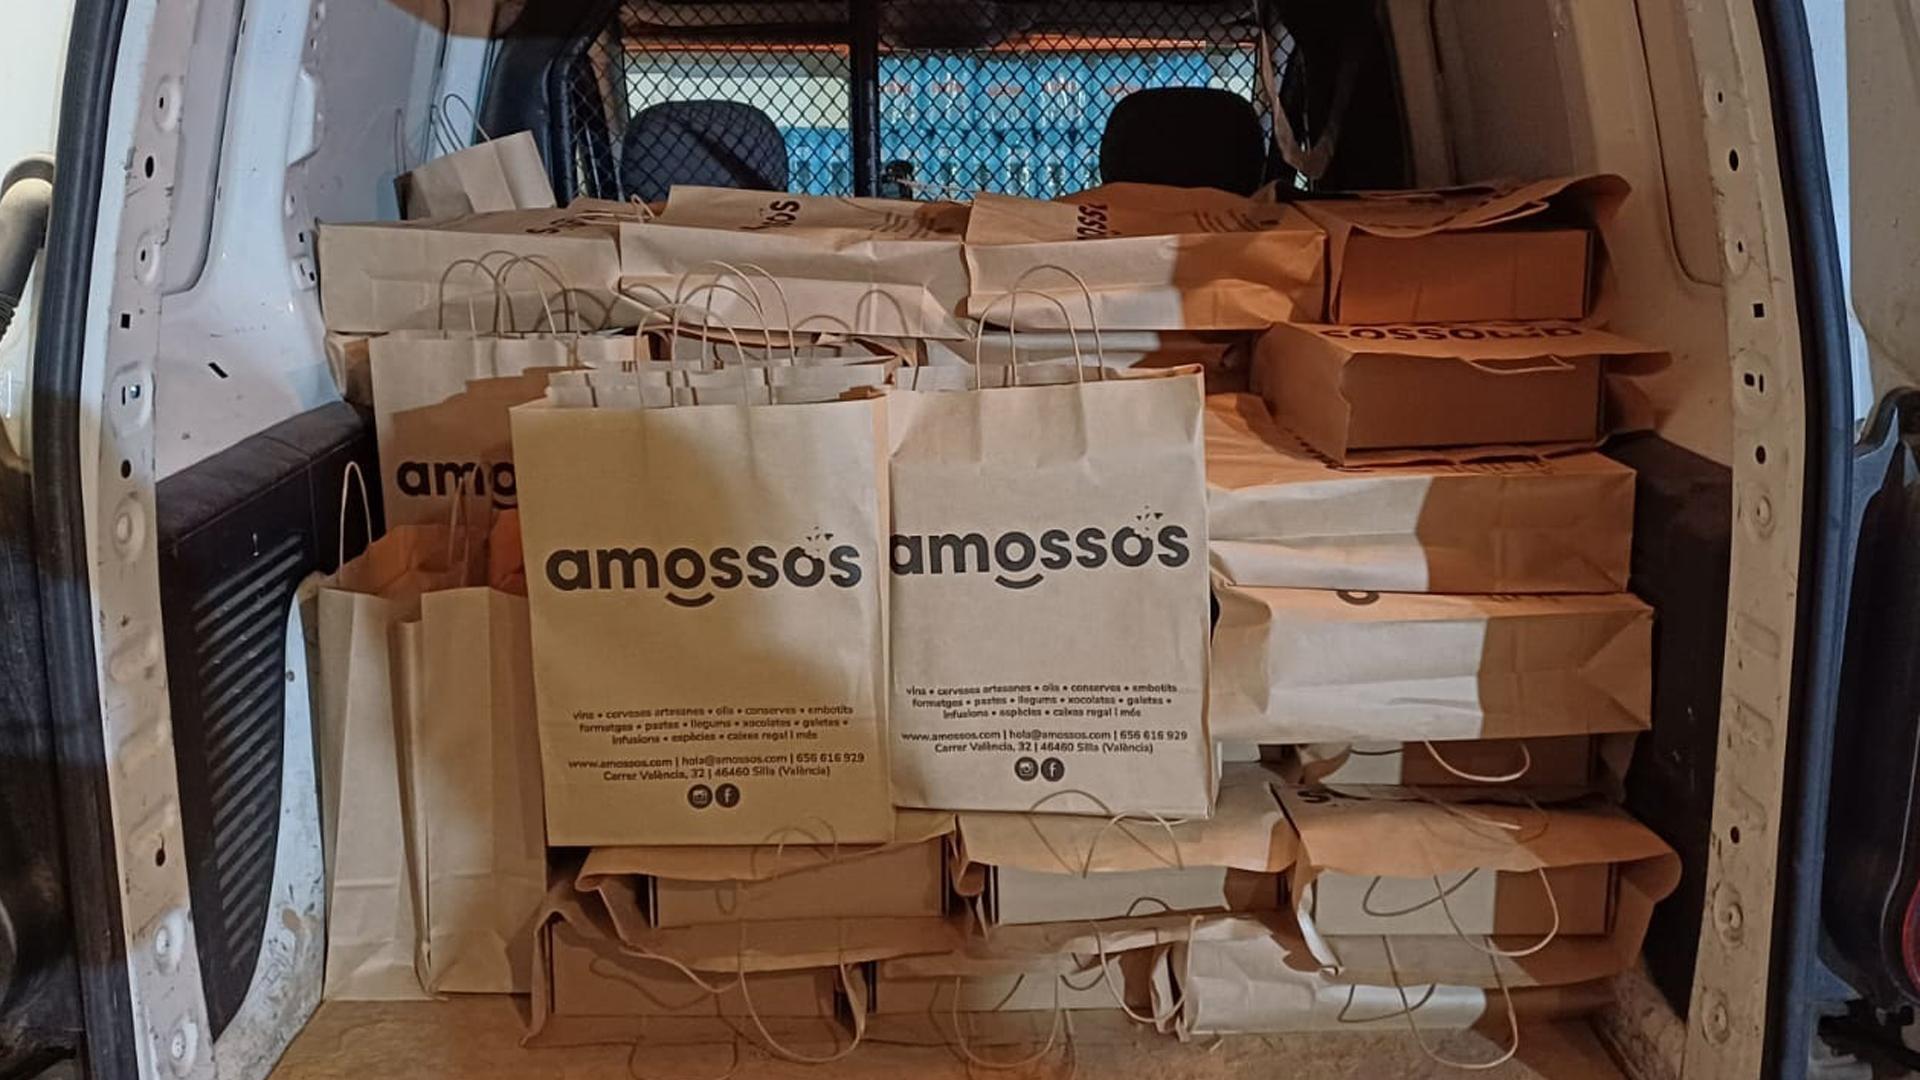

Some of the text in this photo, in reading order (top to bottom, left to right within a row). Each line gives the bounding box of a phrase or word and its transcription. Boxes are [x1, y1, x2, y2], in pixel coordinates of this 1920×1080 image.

[890, 525, 1190, 588] amossos
[546, 545, 862, 606] amossos
[1071, 684, 1121, 692] conserves
[1132, 683, 1177, 692] embotits
[912, 698, 963, 708] formatges
[745, 706, 796, 715] conserves
[808, 705, 854, 714] embotits
[579, 722, 633, 733] formatges
[901, 730, 1000, 741] www.amossos.com
[1009, 729, 1111, 740] hola@amossos.com
[1166, 730, 1188, 740] 929
[935, 743, 967, 753] Carrer
[1018, 742, 1031, 751] 32
[568, 758, 672, 769] www.amossos.com
[682, 754, 787, 766] hola@amossos.com
[843, 752, 865, 763] 929
[603, 771, 637, 781] Carrer
[714, 767, 750, 777] 46460
